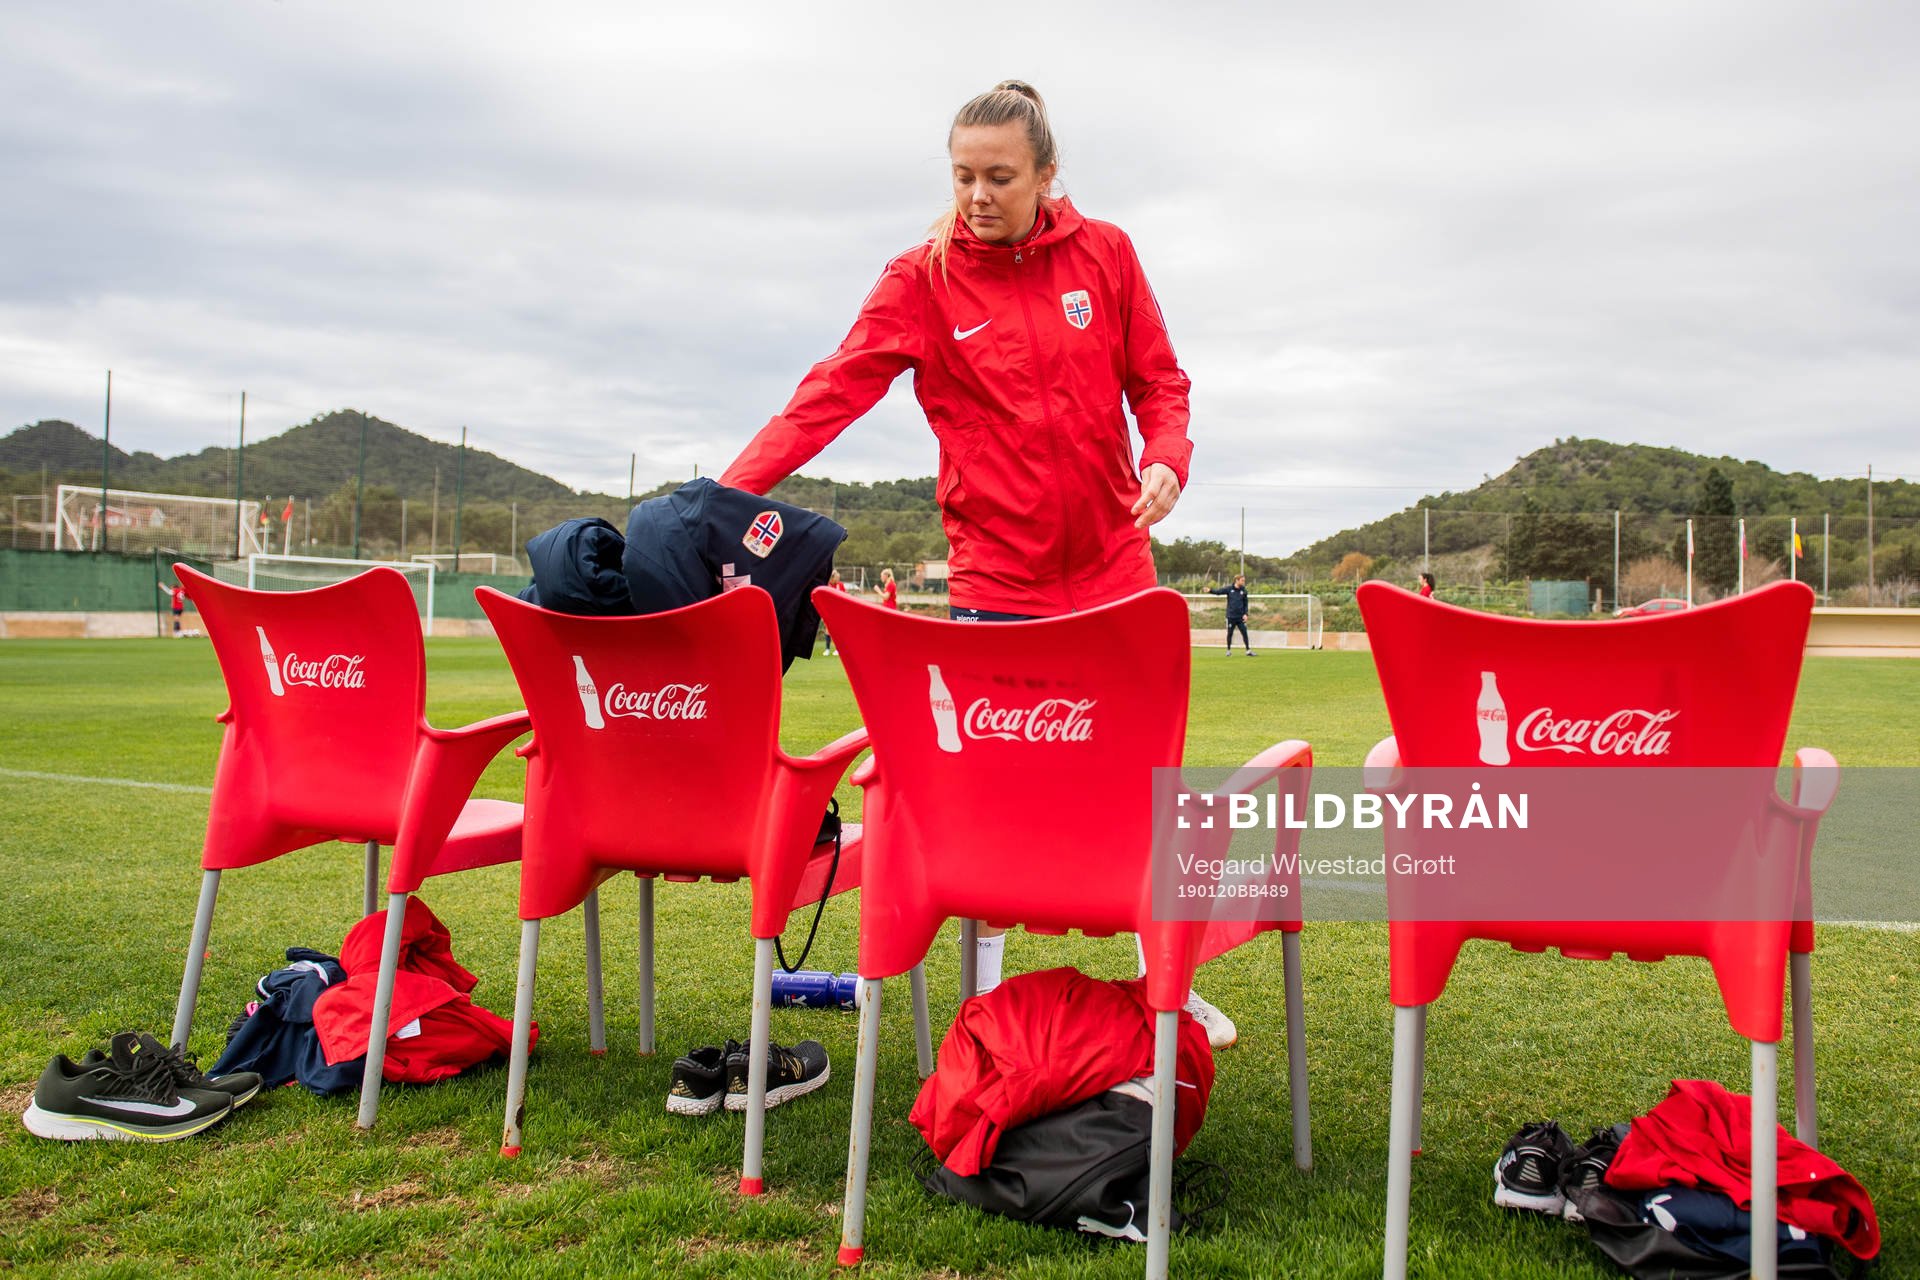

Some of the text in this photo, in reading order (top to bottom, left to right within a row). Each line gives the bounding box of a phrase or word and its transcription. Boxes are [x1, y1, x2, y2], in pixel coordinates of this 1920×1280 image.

[283, 653, 366, 688] Coca-Cola
[605, 683, 709, 720] Coca-Cola
[964, 698, 1097, 742] Coca-Cola
[1516, 707, 1681, 755] Coca-Cola
